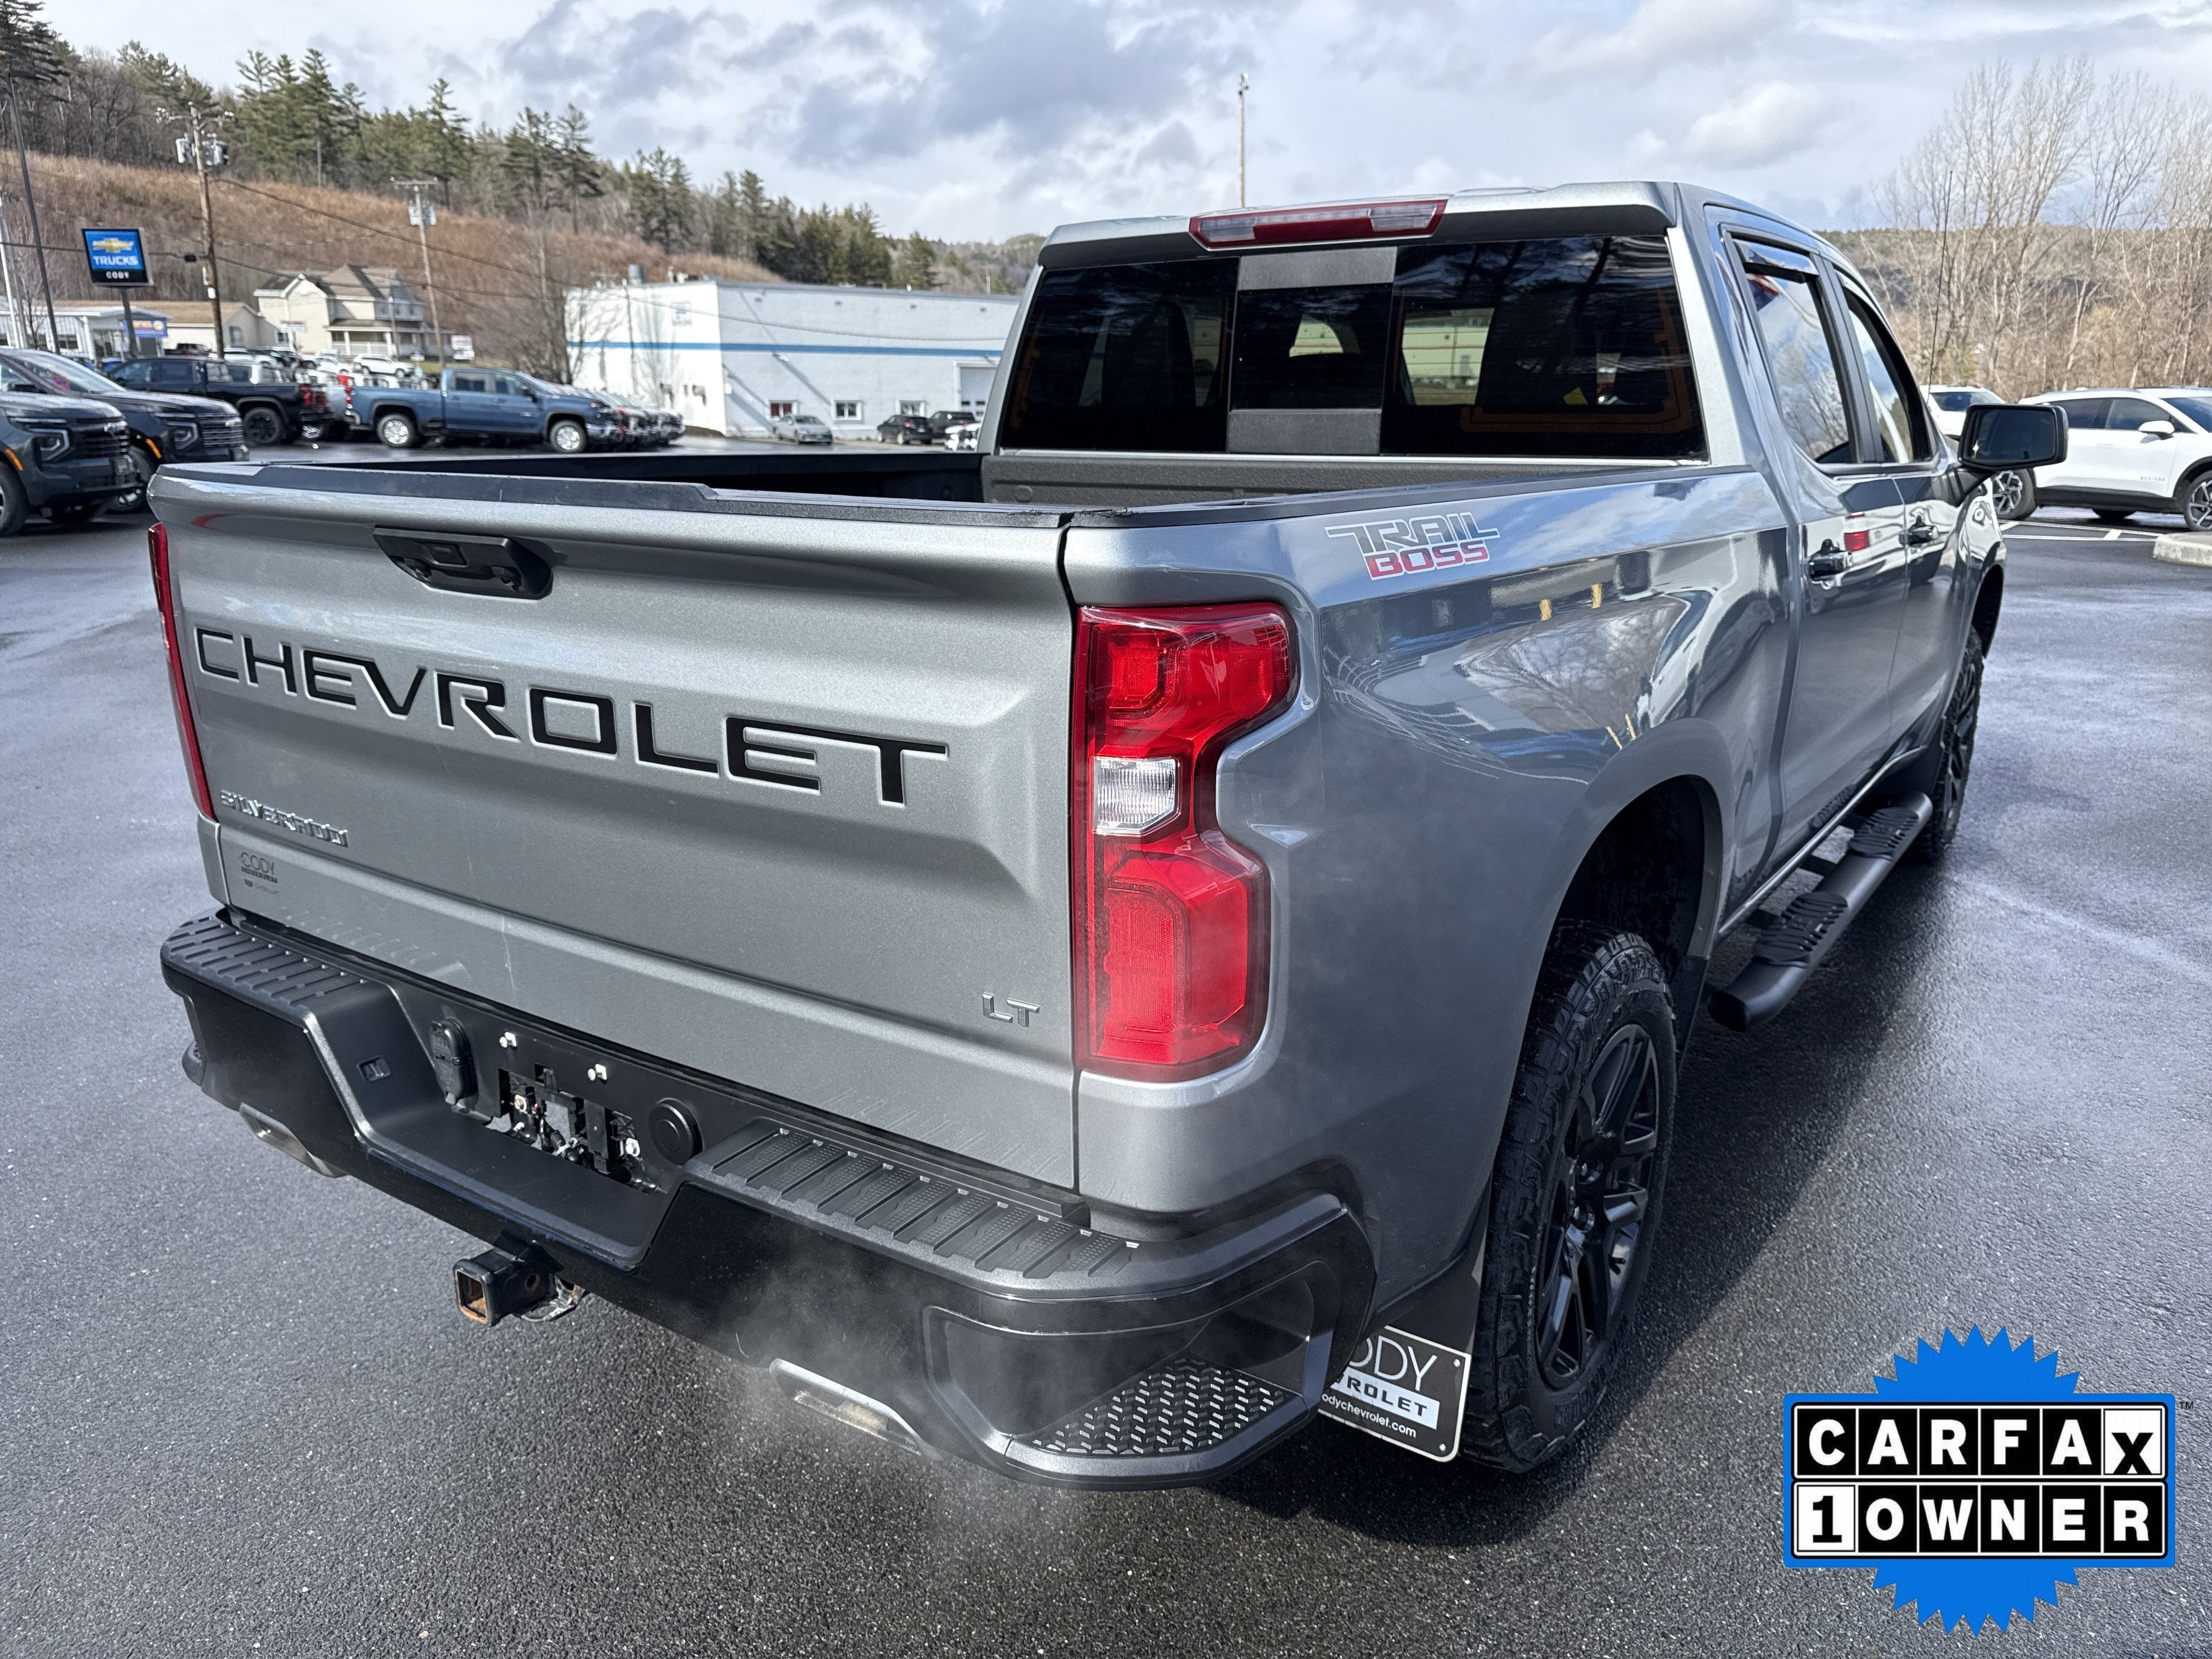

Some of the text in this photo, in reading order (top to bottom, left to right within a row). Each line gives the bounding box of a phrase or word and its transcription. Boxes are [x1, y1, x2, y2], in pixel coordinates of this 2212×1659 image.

[93, 255, 139, 266] TRUCKS
[1324, 512, 1500, 554] TRAIL
[1364, 540, 1490, 580] BOSS
[195, 627, 949, 808] CHEVROLET
[238, 851, 275, 876] CODY
[982, 992, 1040, 1028] LT
[1336, 1375, 1427, 1417] ROLET
